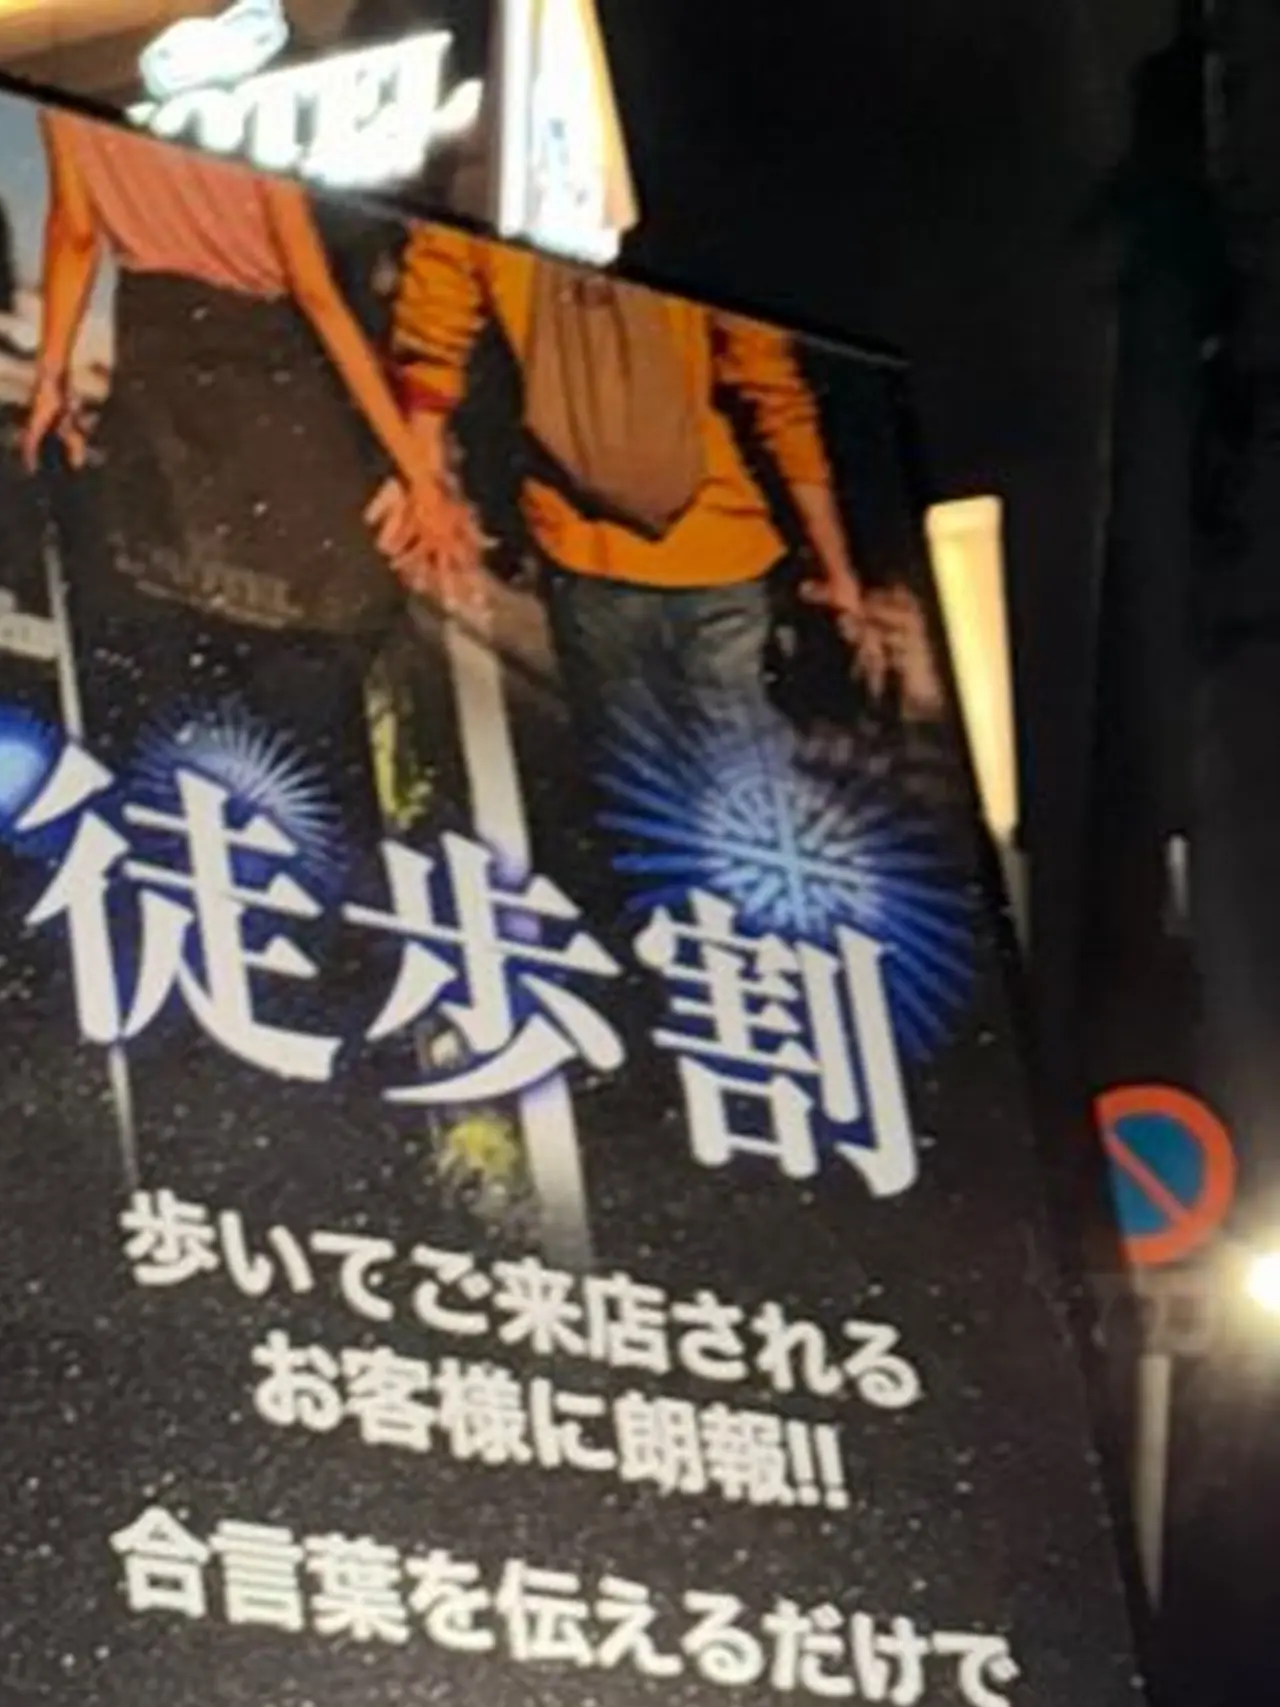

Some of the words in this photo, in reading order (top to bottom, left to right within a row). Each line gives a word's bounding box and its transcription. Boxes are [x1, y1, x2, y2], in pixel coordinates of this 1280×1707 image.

[14, 743, 921, 1200] 徒歩割
[120, 1188, 921, 1410] 歩いてご来店される
[251, 1333, 849, 1509] お客様に朗報!!
